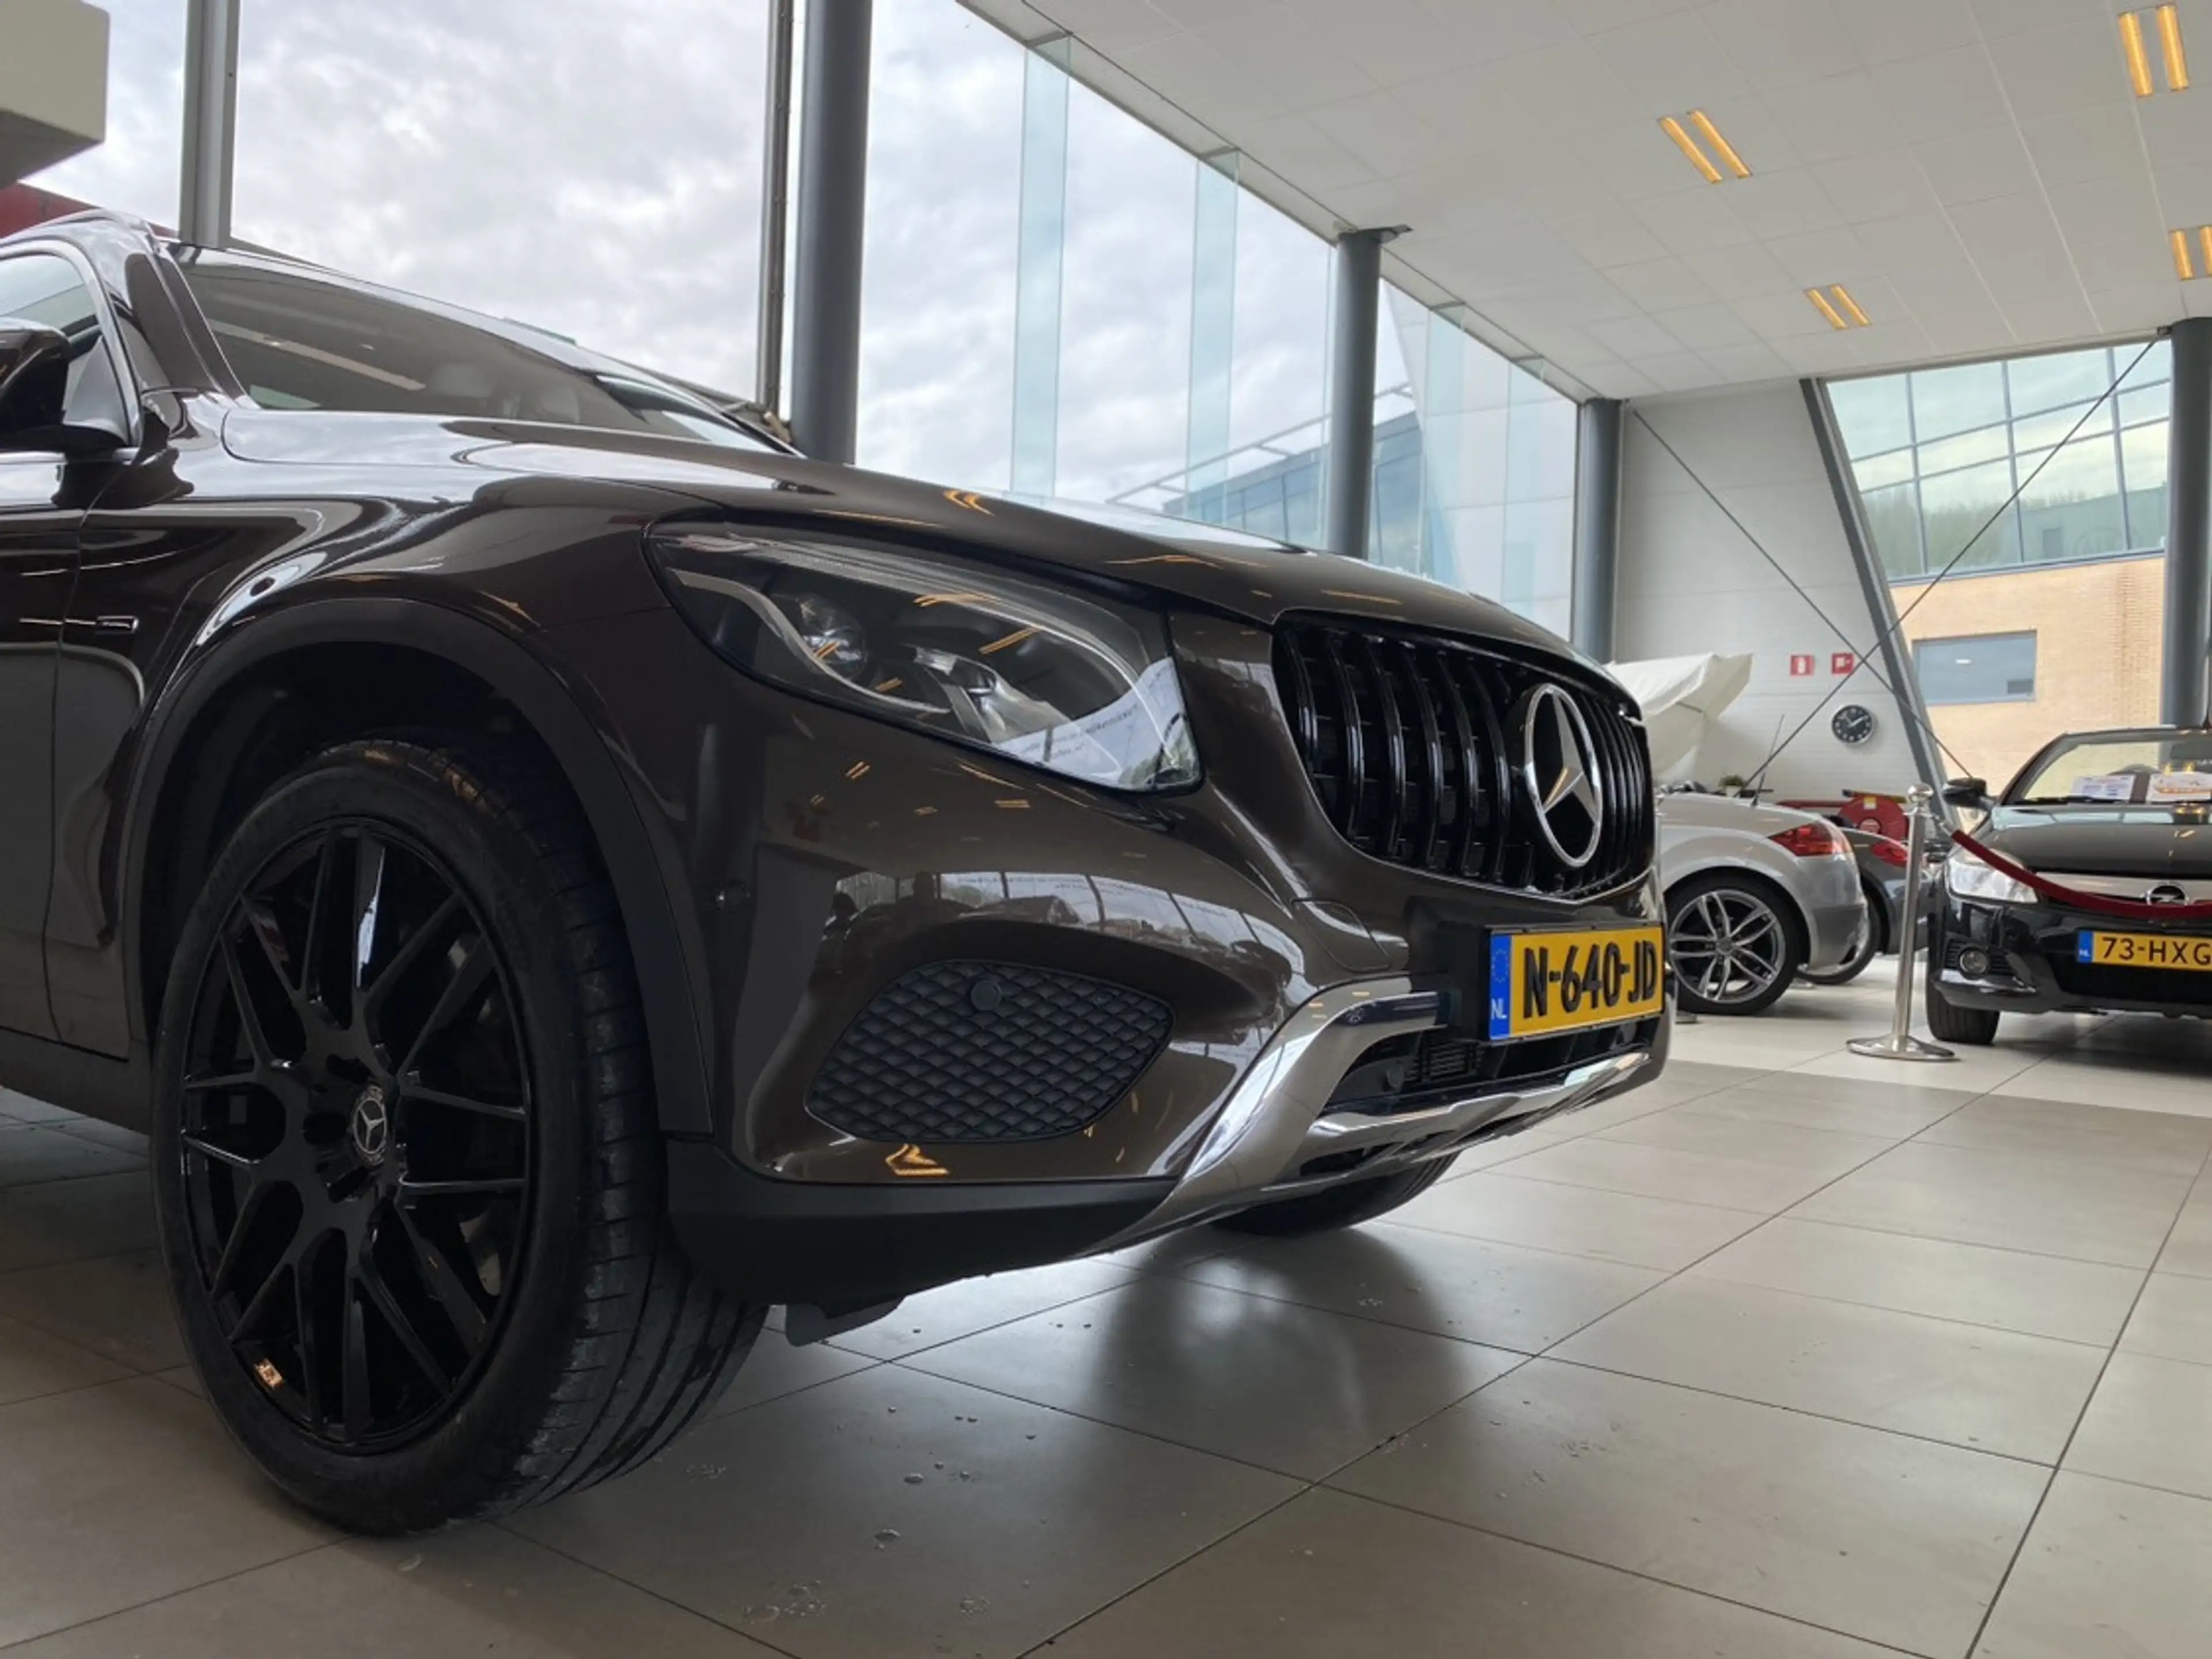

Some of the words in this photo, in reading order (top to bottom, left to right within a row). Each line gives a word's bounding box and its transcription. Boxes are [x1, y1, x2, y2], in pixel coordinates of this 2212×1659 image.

[2103, 937, 2211, 965] 73-HXG
[1524, 940, 1657, 1018] N-640-JD
[1491, 998, 1507, 1020] NL
